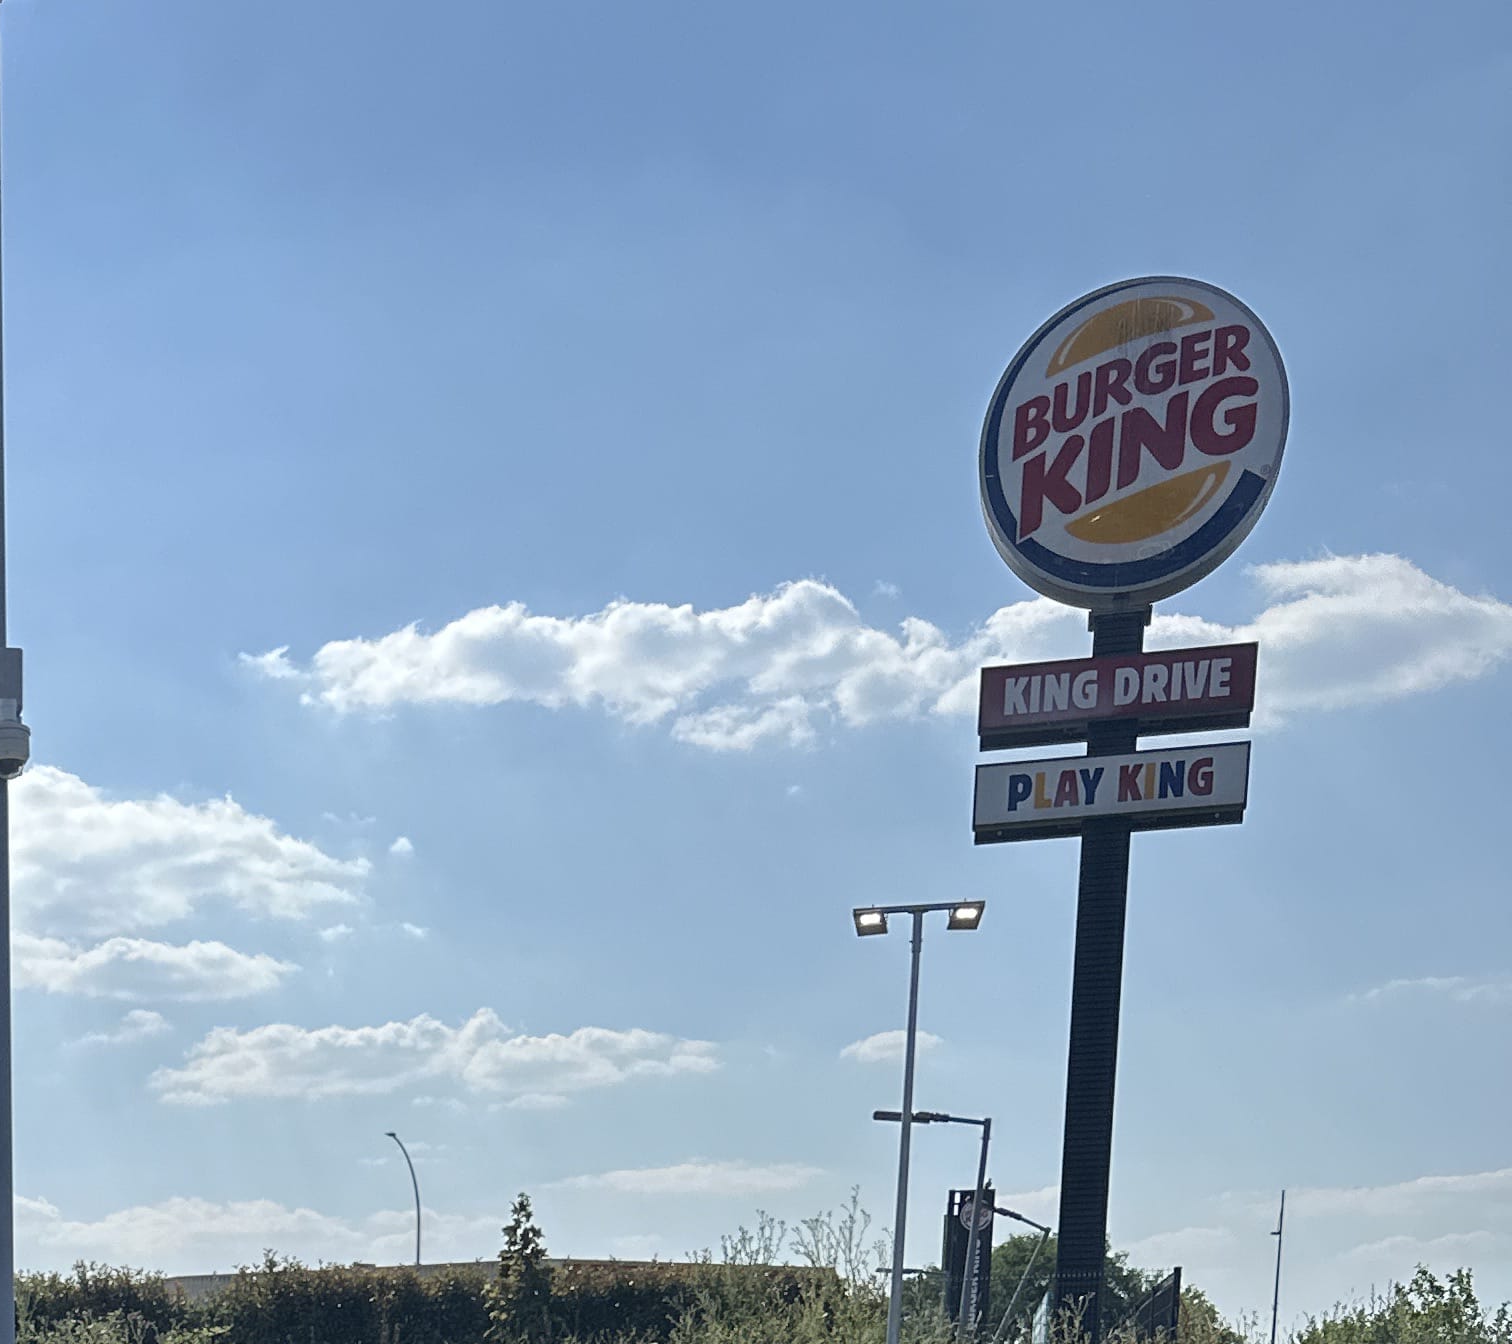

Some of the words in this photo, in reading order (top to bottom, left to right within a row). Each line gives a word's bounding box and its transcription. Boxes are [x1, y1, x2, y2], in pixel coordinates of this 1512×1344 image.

[1013, 325, 1251, 461] BURGER
[1020, 376, 1259, 539] KING
[1003, 670, 1098, 716] KING
[1113, 658, 1232, 706] DRIVE
[1008, 767, 1104, 812] PLAY
[1117, 757, 1214, 802] KING
